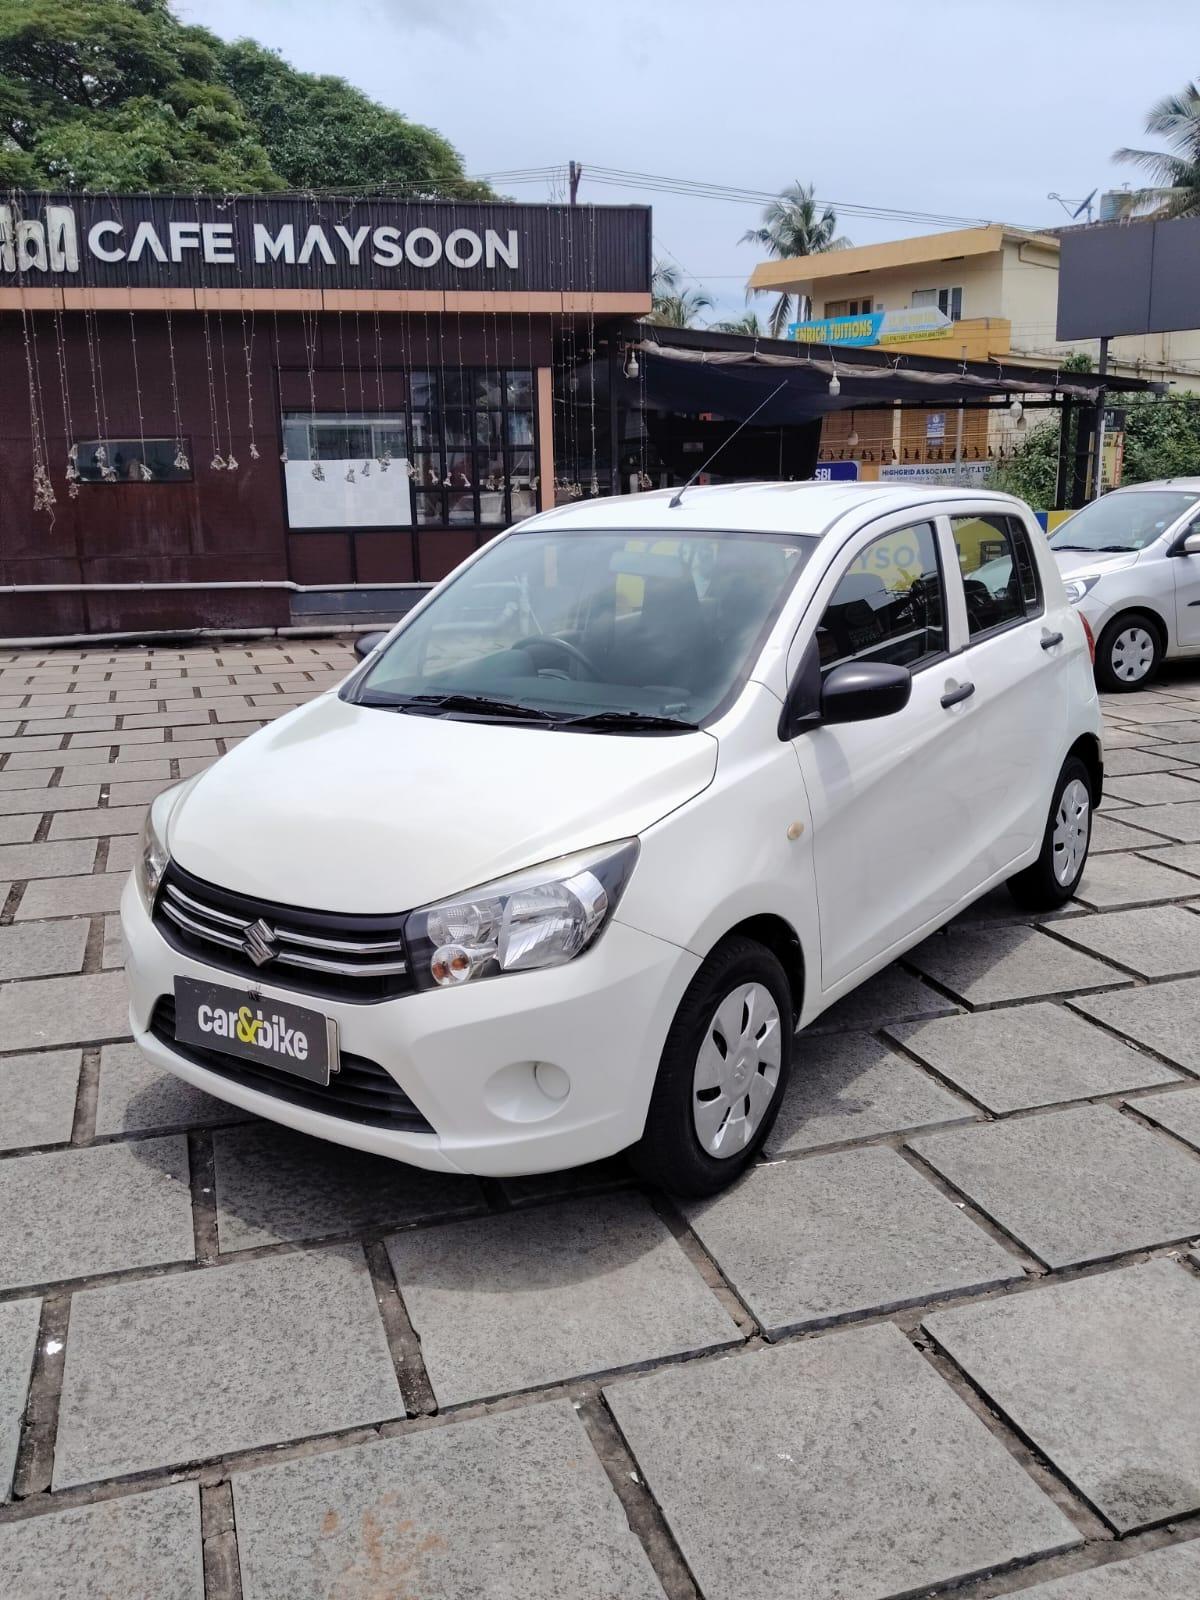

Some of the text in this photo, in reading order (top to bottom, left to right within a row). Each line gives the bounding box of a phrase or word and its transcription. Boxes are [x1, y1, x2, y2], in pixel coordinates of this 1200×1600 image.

[87, 220, 519, 269] CAFE MAYSOON
[795, 325, 827, 343] ENRICH
[830, 319, 873, 339] TUITIONS
[814, 468, 831, 480] SBI
[916, 467, 958, 476] ASSOCIATE
[197, 1004, 308, 1061] car&bike
